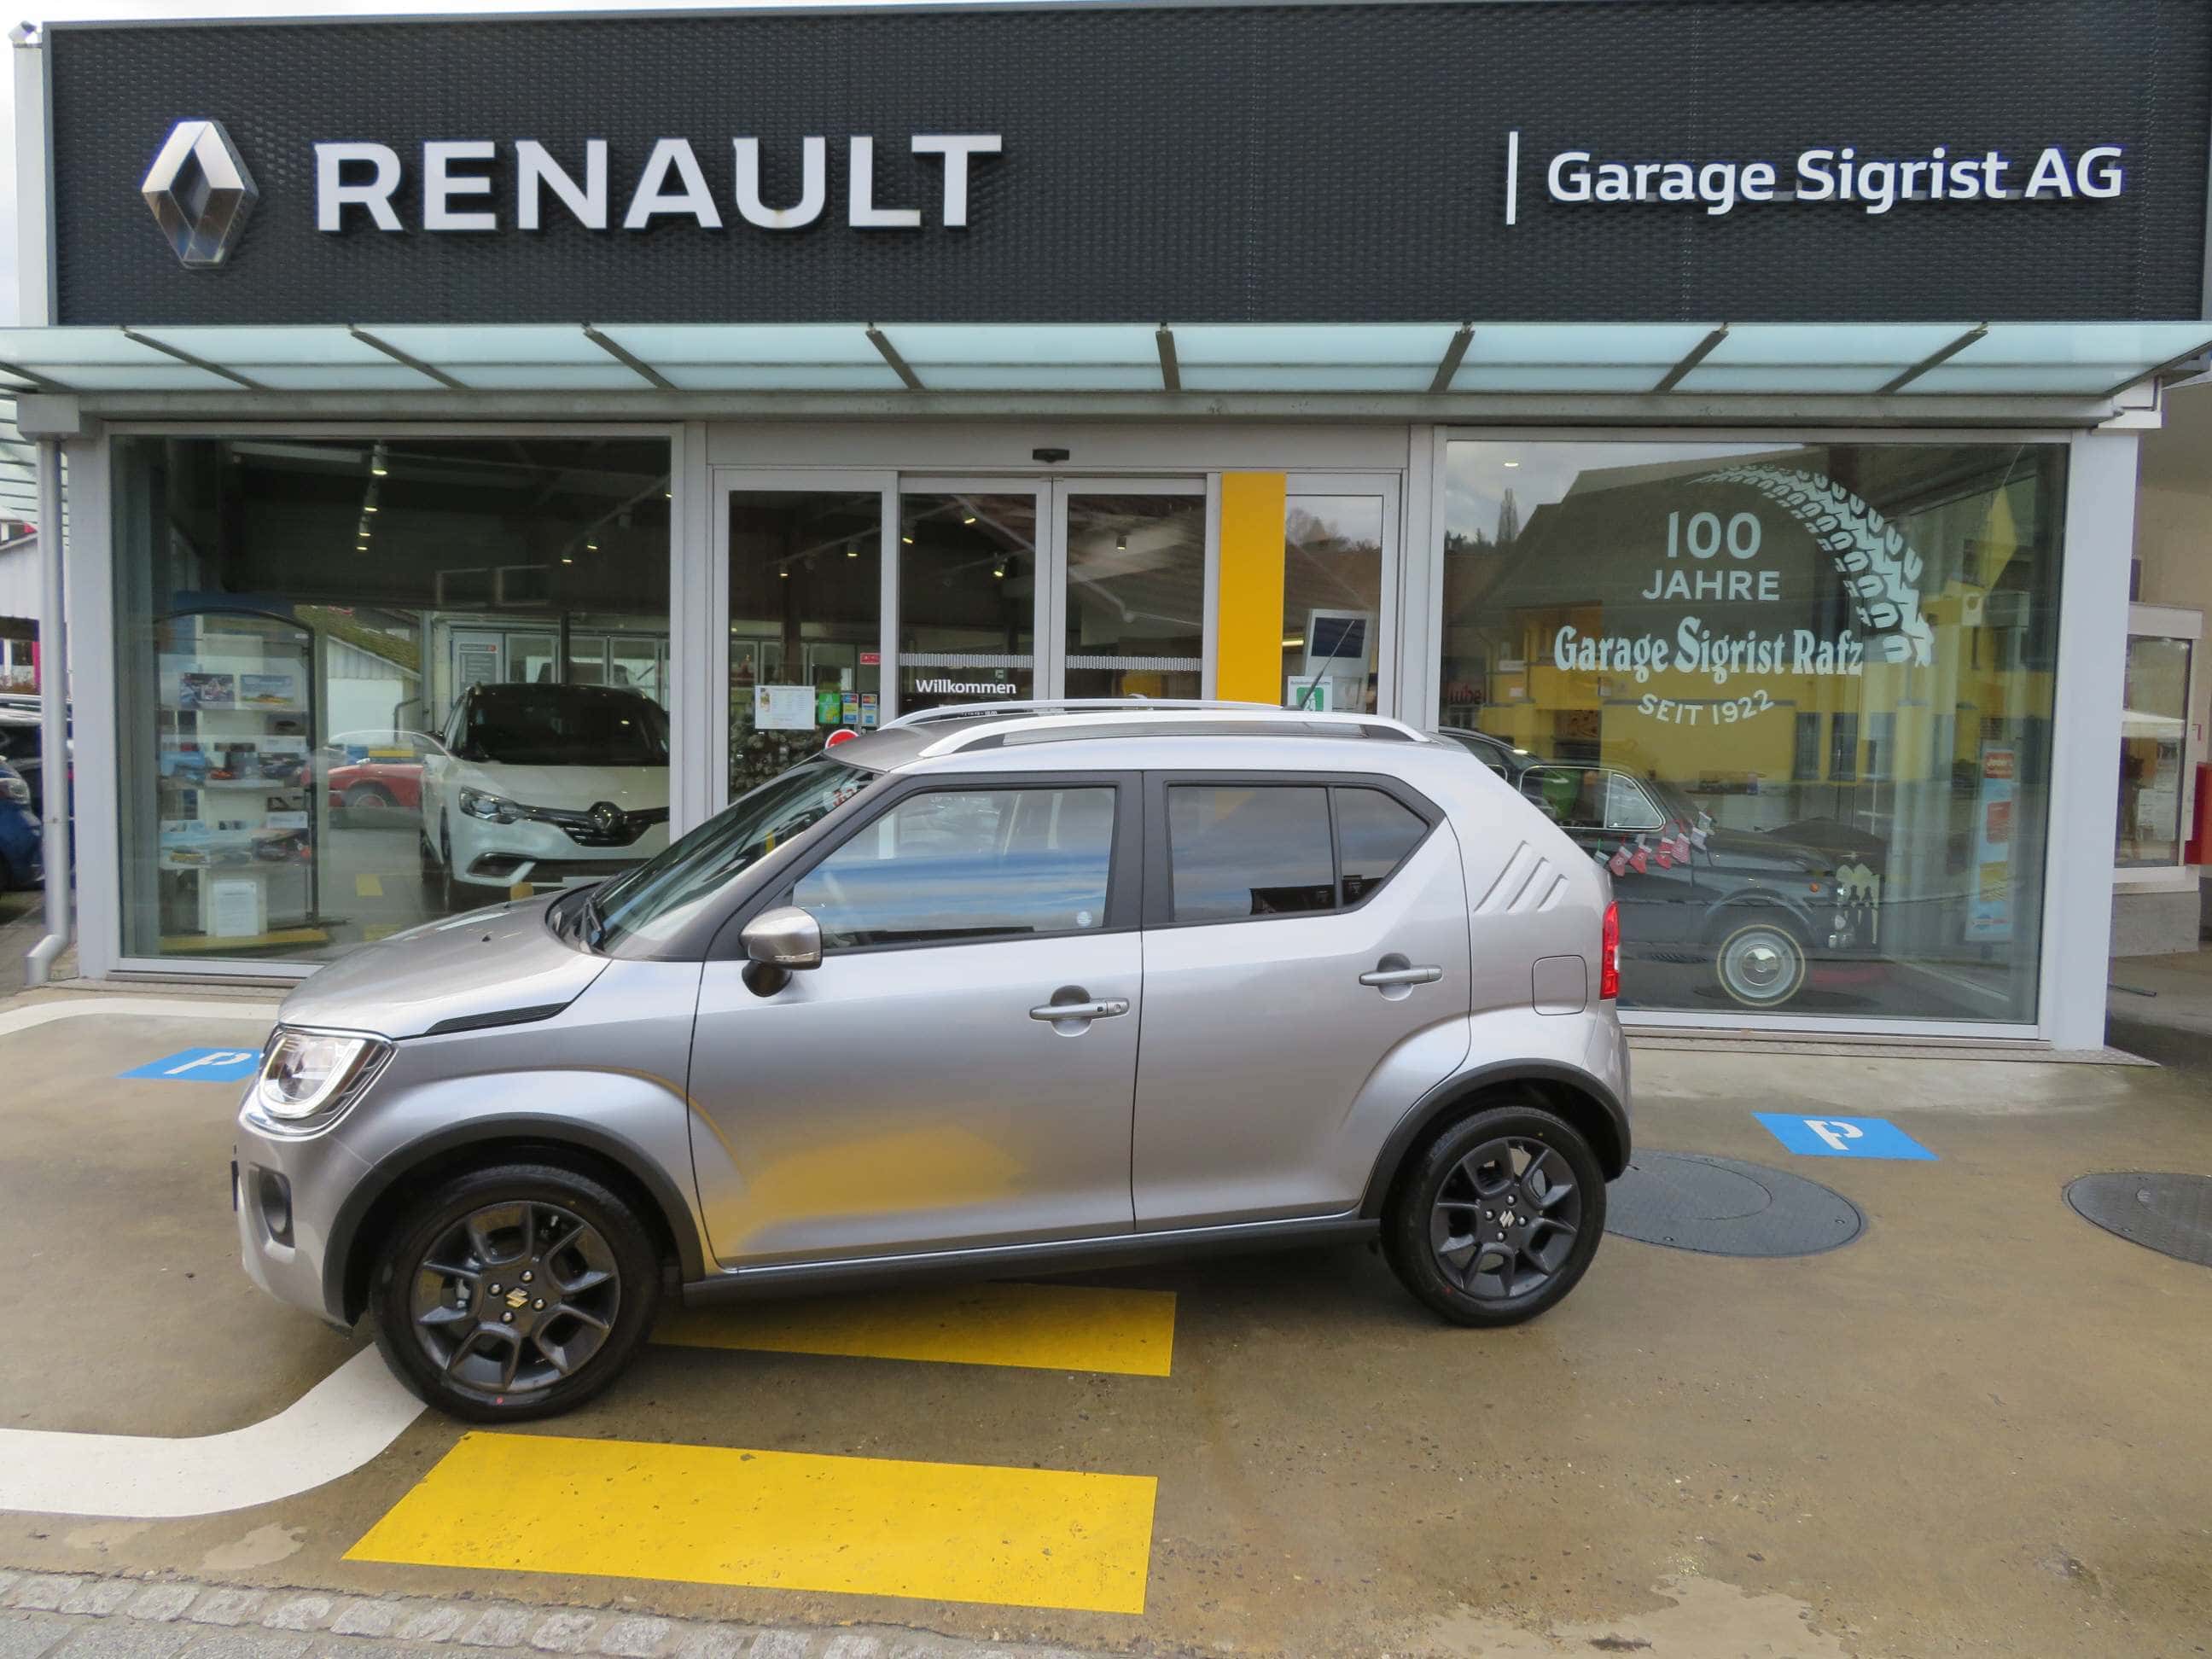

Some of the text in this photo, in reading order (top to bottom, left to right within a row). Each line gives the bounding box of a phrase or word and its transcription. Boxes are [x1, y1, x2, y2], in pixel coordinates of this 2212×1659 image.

[313, 134, 1002, 231] RENAULT
[1547, 146, 2123, 214] Garage Sigrist AG
[1667, 511, 1761, 560] 100
[1642, 569, 1780, 601] JAHRE
[1553, 615, 1864, 684] Garage Sigrist Rafz
[915, 679, 1016, 695] Willkommen
[1637, 689, 1775, 725] SEIT 1922
[163, 1051, 253, 1075] P
[1802, 1120, 1864, 1151] P
